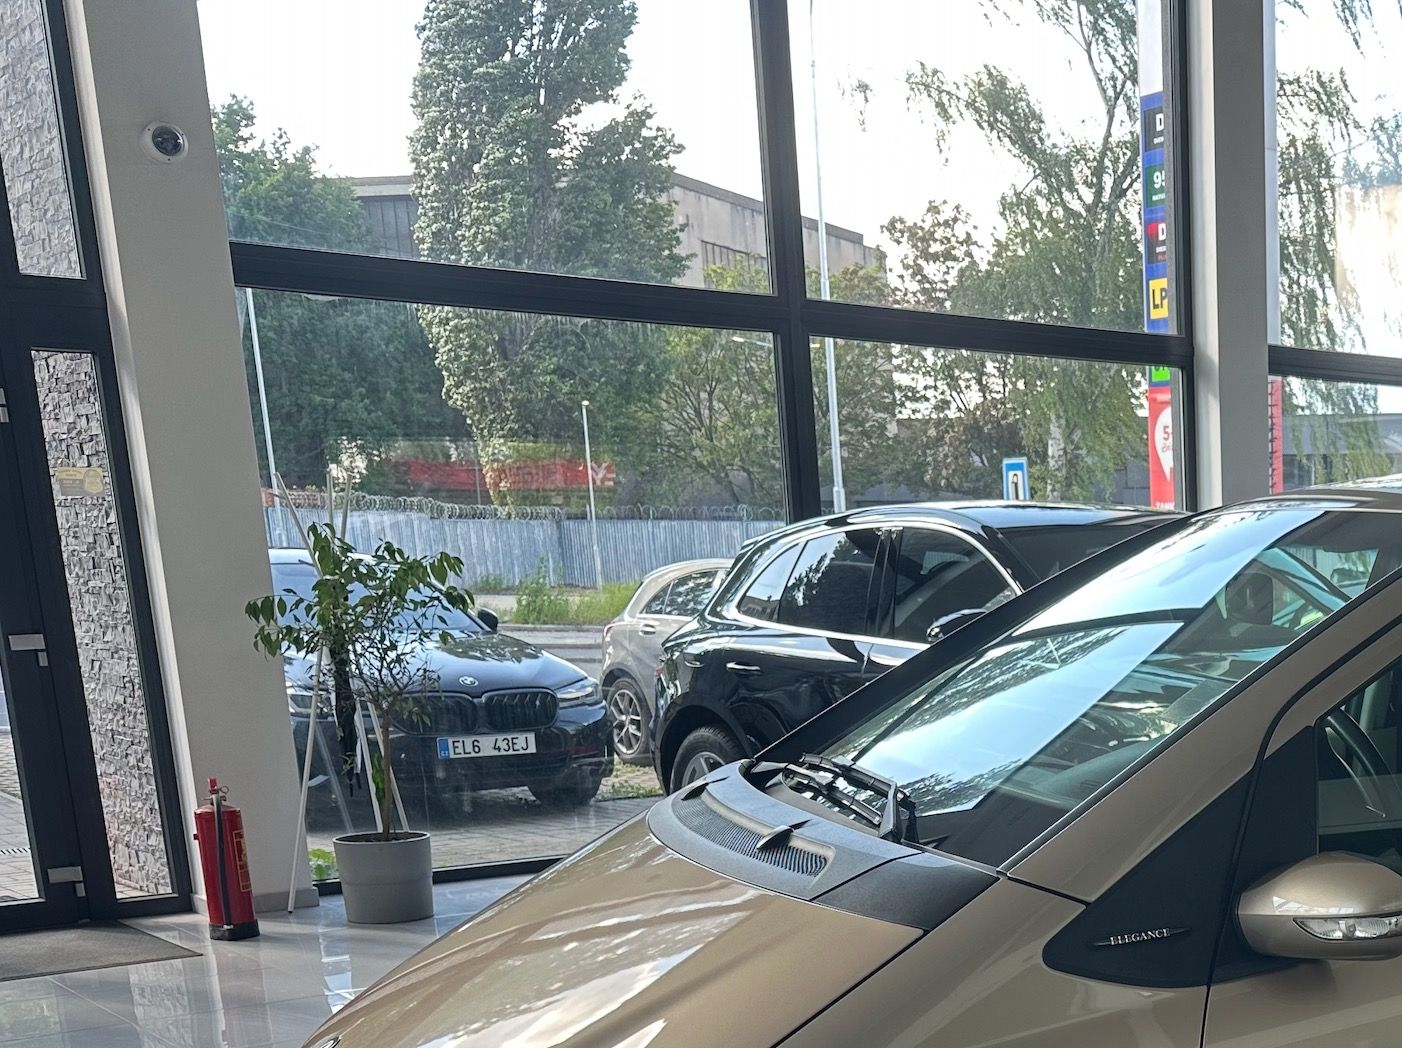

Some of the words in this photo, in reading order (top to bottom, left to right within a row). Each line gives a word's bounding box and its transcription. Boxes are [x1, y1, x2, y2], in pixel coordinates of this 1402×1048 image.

[452, 739, 481, 756] EL6
[493, 736, 529, 753] 43EJ
[1109, 927, 1172, 946] ELEGANCE
